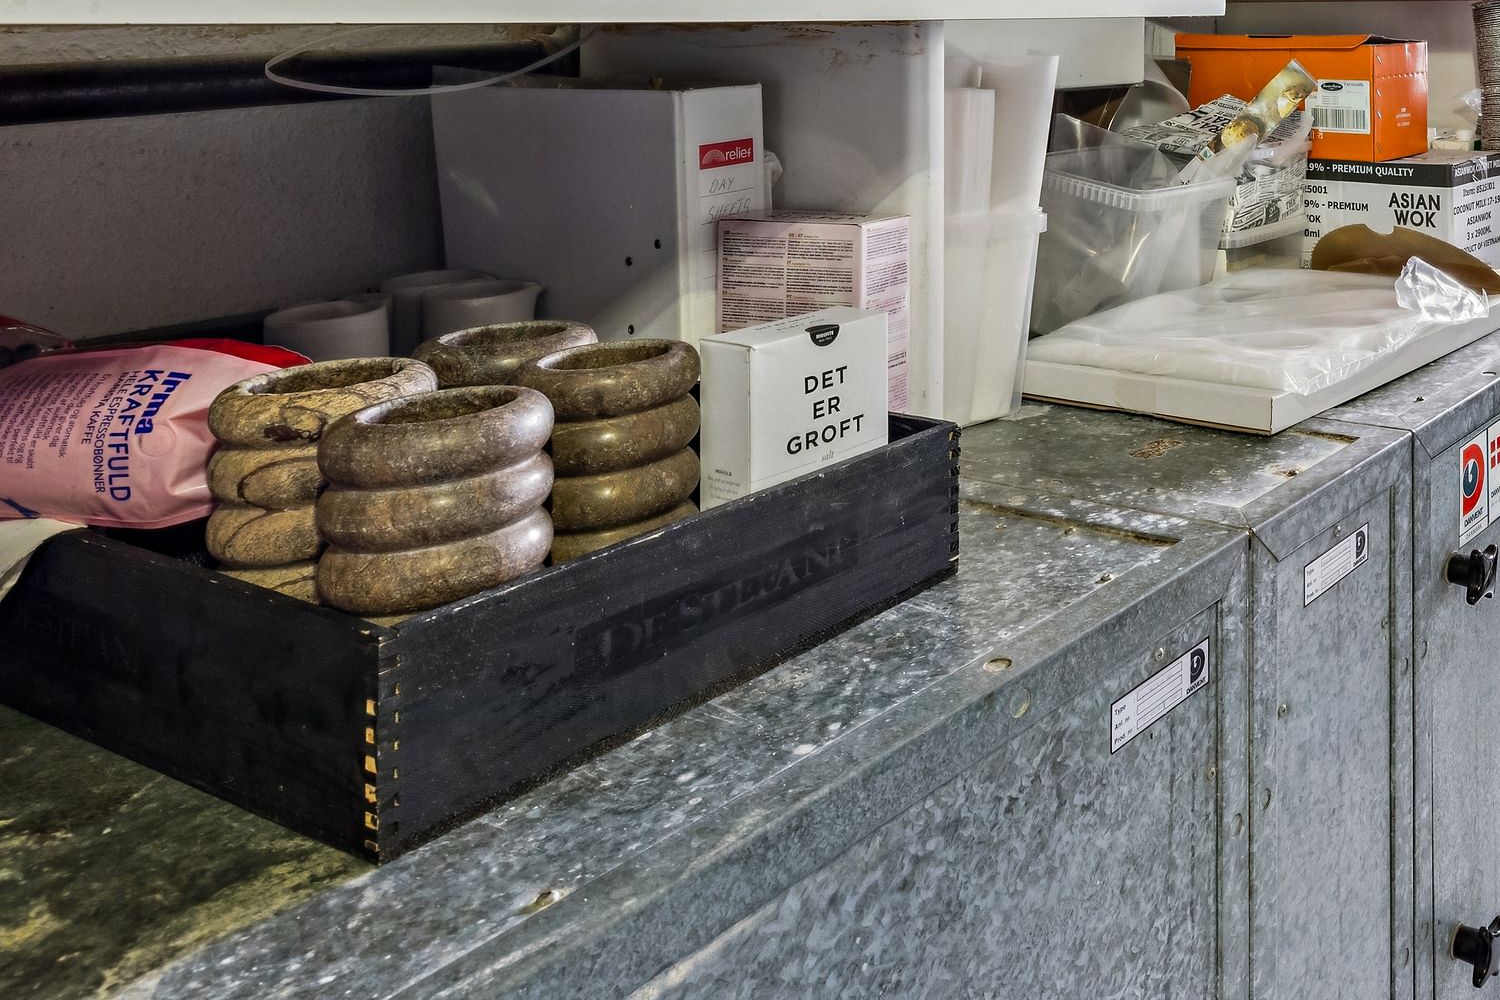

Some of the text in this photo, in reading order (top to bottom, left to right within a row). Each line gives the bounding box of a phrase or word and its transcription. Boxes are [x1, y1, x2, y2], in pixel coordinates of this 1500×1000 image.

[725, 147, 752, 160] relief
[1332, 163, 1373, 174] PREMIUM
[1375, 166, 1414, 177] QUALITY
[709, 178, 734, 193] DAY
[708, 197, 750, 222] SHEETS
[1327, 201, 1369, 212] PREMIUM
[1388, 192, 1440, 211] ASIAN
[1453, 202, 1475, 215] COCONUT
[1475, 199, 1487, 209] MILK
[1306, 214, 1321, 223] OK
[1394, 209, 1437, 228] WOK
[1466, 211, 1492, 226] ASIANWOK
[804, 366, 848, 395] DET
[63, 403, 74, 415] der
[81, 371, 129, 445] BARISTA KAFFE
[135, 371, 192, 435] Irma
[813, 396, 841, 420] ER
[33, 407, 53, 439] Kraftfuld
[69, 409, 80, 420] og
[23, 418, 36, 442] intens
[54, 416, 67, 434] giver
[93, 371, 140, 493] HELE ESPRESSOBØNNER
[786, 414, 864, 455] GROFT
[49, 435, 59, 448] dig
[58, 420, 76, 458] aromatisk
[108, 370, 164, 501] KRAFTFULD
[26, 449, 36, 469] skabt
[821, 450, 834, 462] salt
[1464, 507, 1483, 527] DANVENT
[1186, 676, 1207, 695] DANVENT
[1114, 704, 1127, 715] Type
